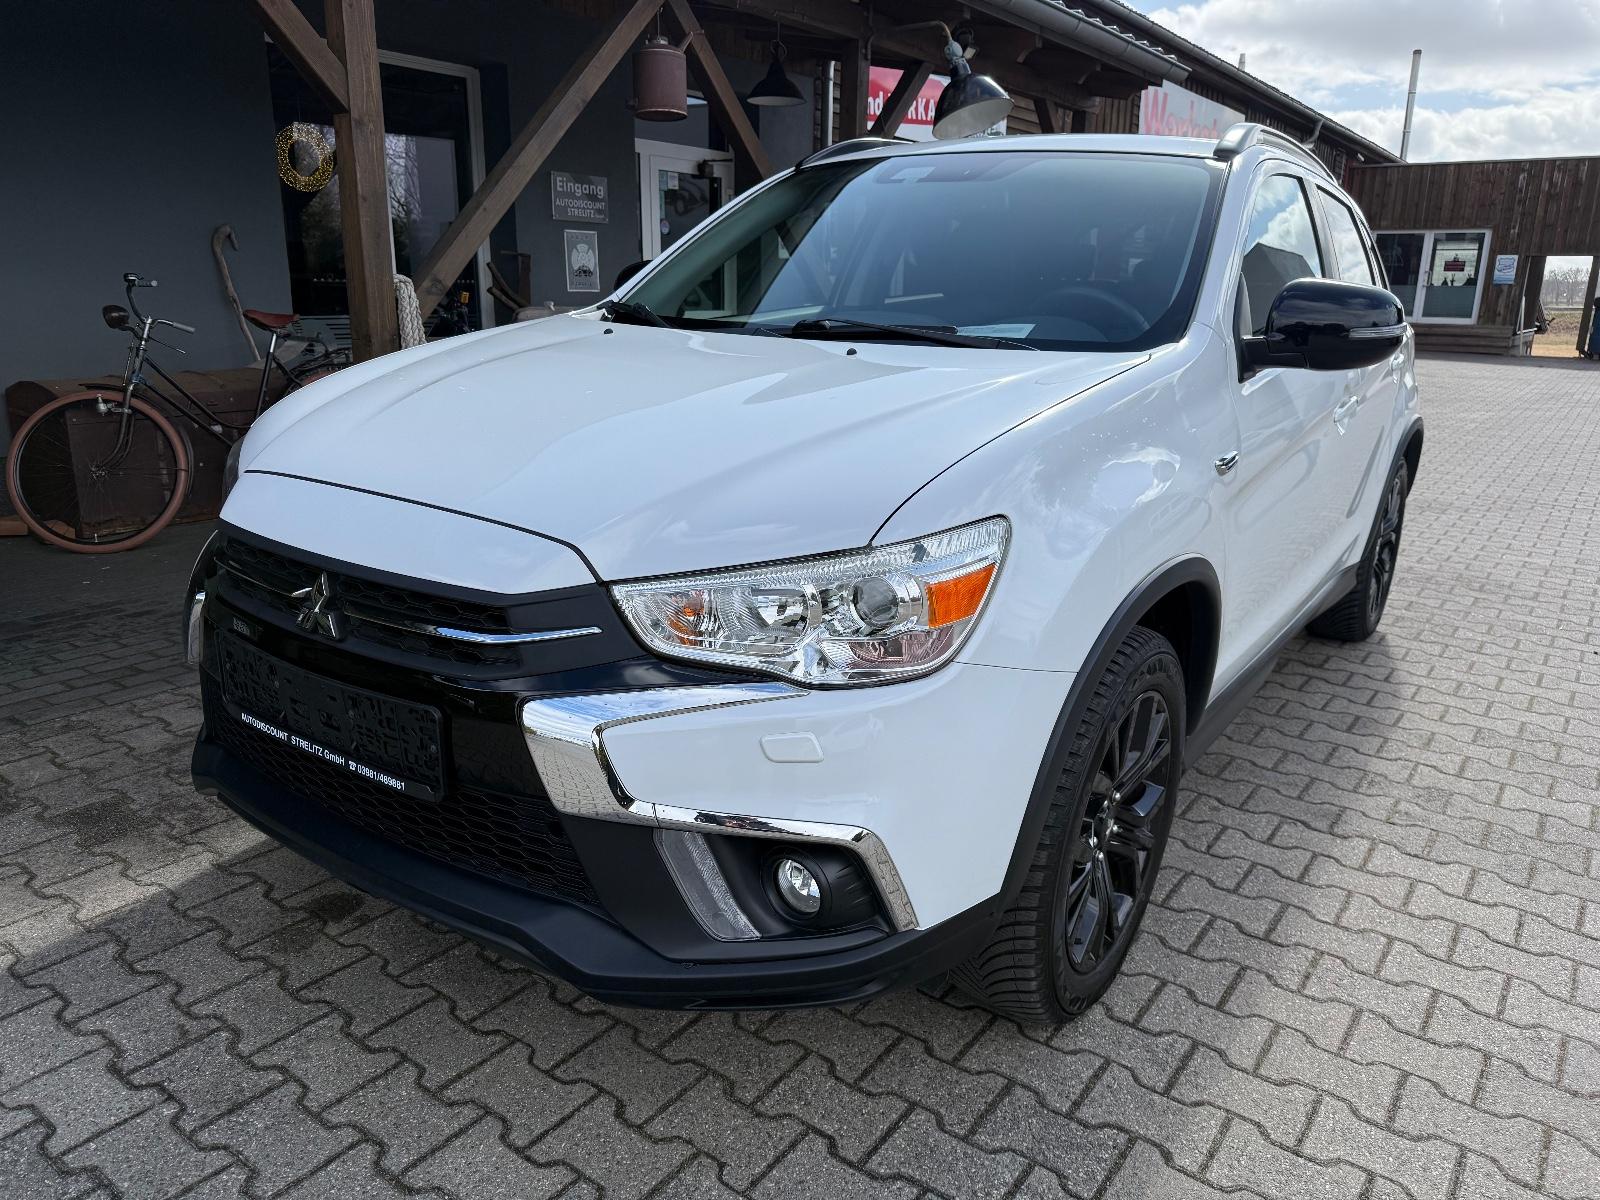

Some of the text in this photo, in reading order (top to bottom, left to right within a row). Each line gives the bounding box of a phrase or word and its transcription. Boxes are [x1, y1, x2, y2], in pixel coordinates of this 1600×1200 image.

[556, 176, 604, 199] Eingang
[555, 197, 605, 210] AUTODISCOUNT
[567, 207, 594, 218] STRELITZ
[241, 712, 405, 791] AUTODISCOUNT STRELITZ GmbH 03981/489881
